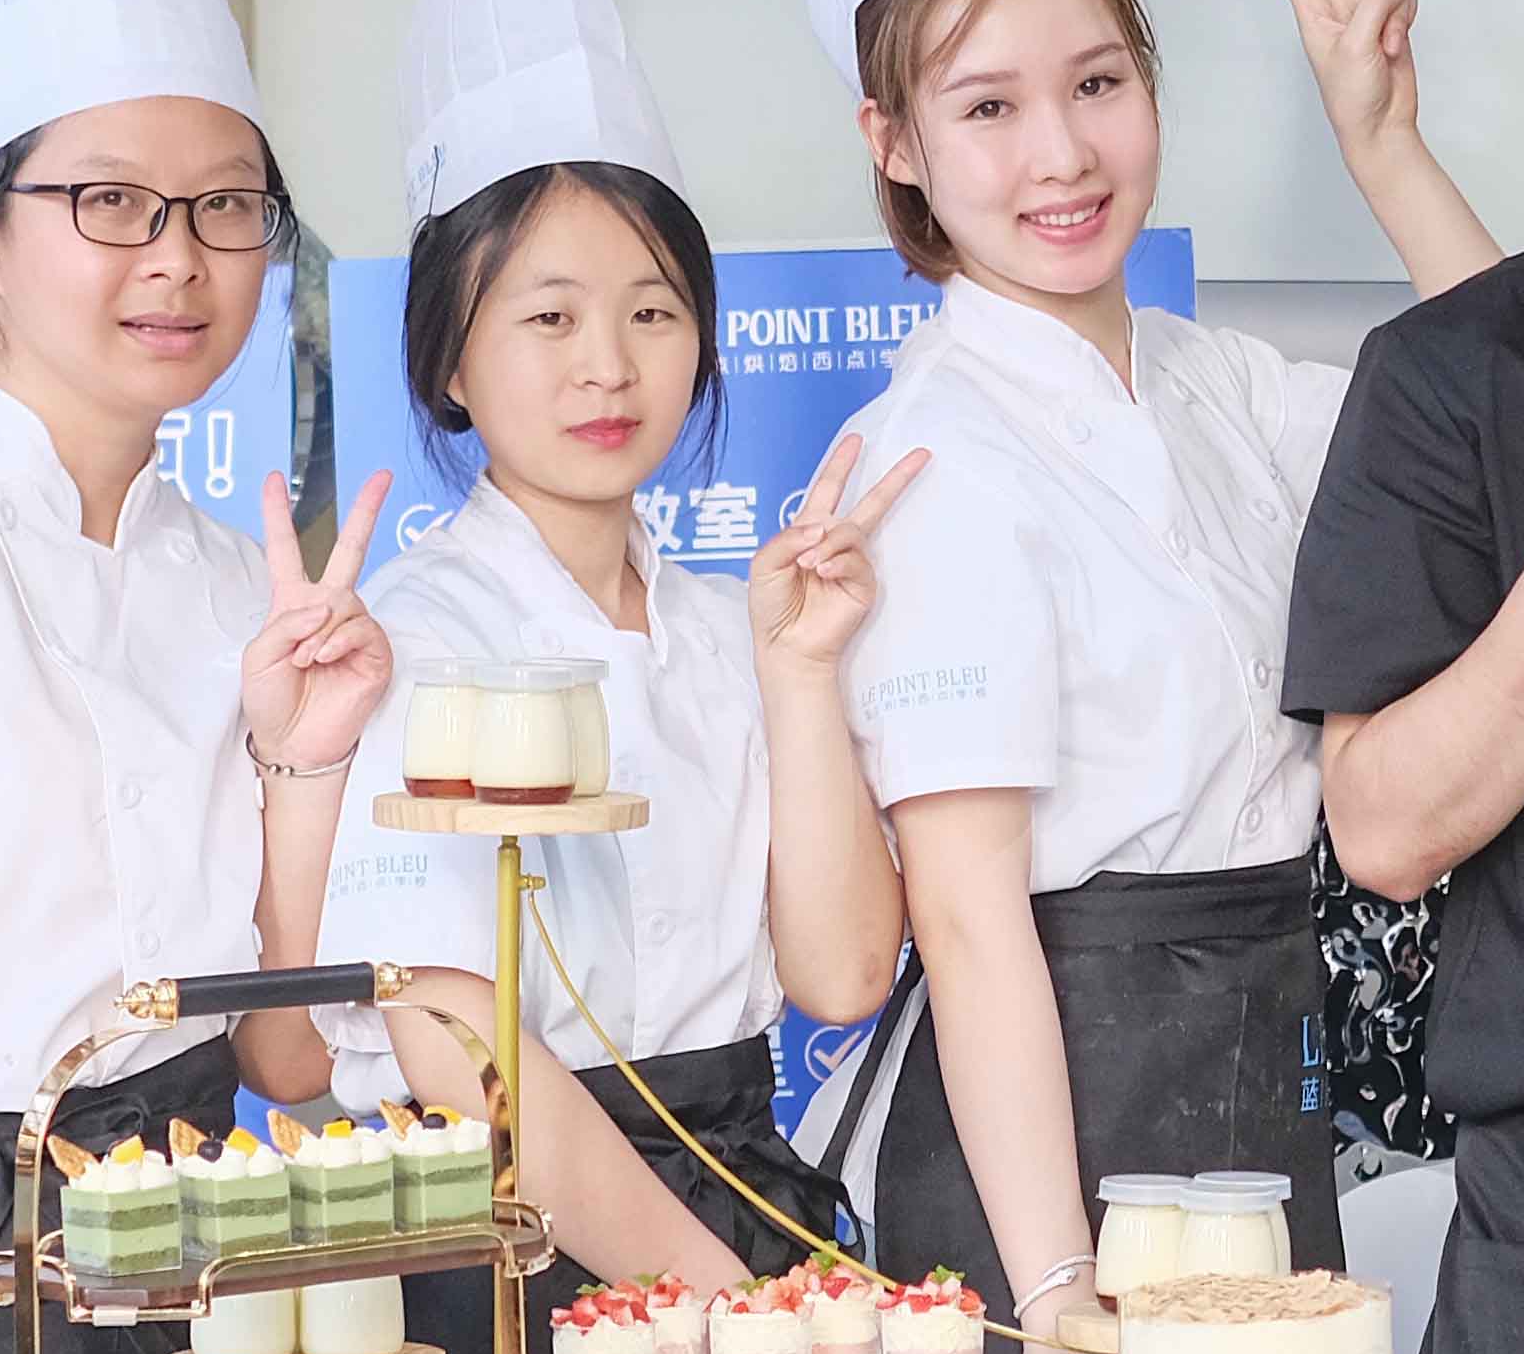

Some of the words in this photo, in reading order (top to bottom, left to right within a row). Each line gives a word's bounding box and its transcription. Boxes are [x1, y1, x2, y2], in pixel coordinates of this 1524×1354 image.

[726, 307, 836, 347] POINT
[878, 669, 932, 702] POINT
[935, 665, 988, 687] BLEU
[375, 853, 428, 875] BLEU
